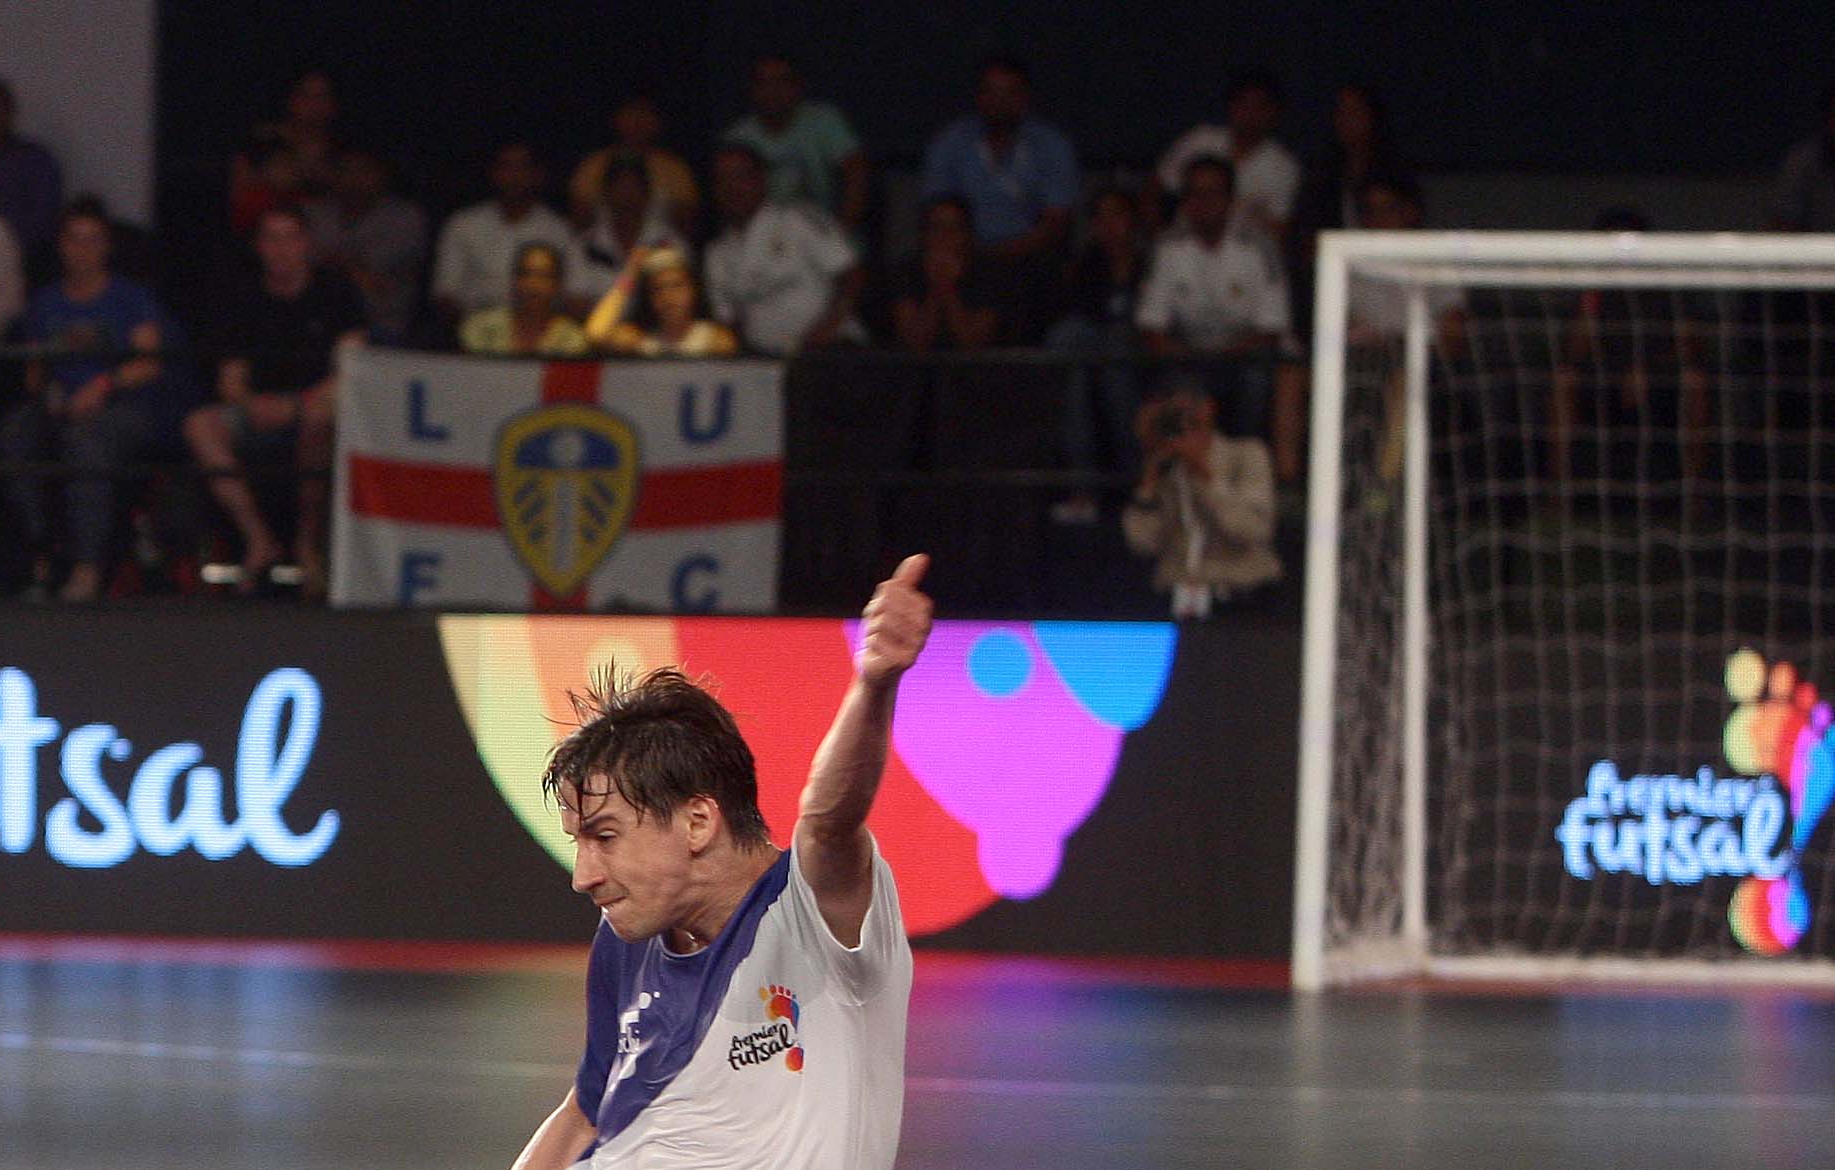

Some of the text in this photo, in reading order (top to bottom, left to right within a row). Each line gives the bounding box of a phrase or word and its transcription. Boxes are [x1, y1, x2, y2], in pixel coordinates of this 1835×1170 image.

[408, 378, 733, 446] L U
[398, 552, 441, 610] F
[1585, 758, 1778, 819] Premier
[732, 1022, 780, 1051] Premier
